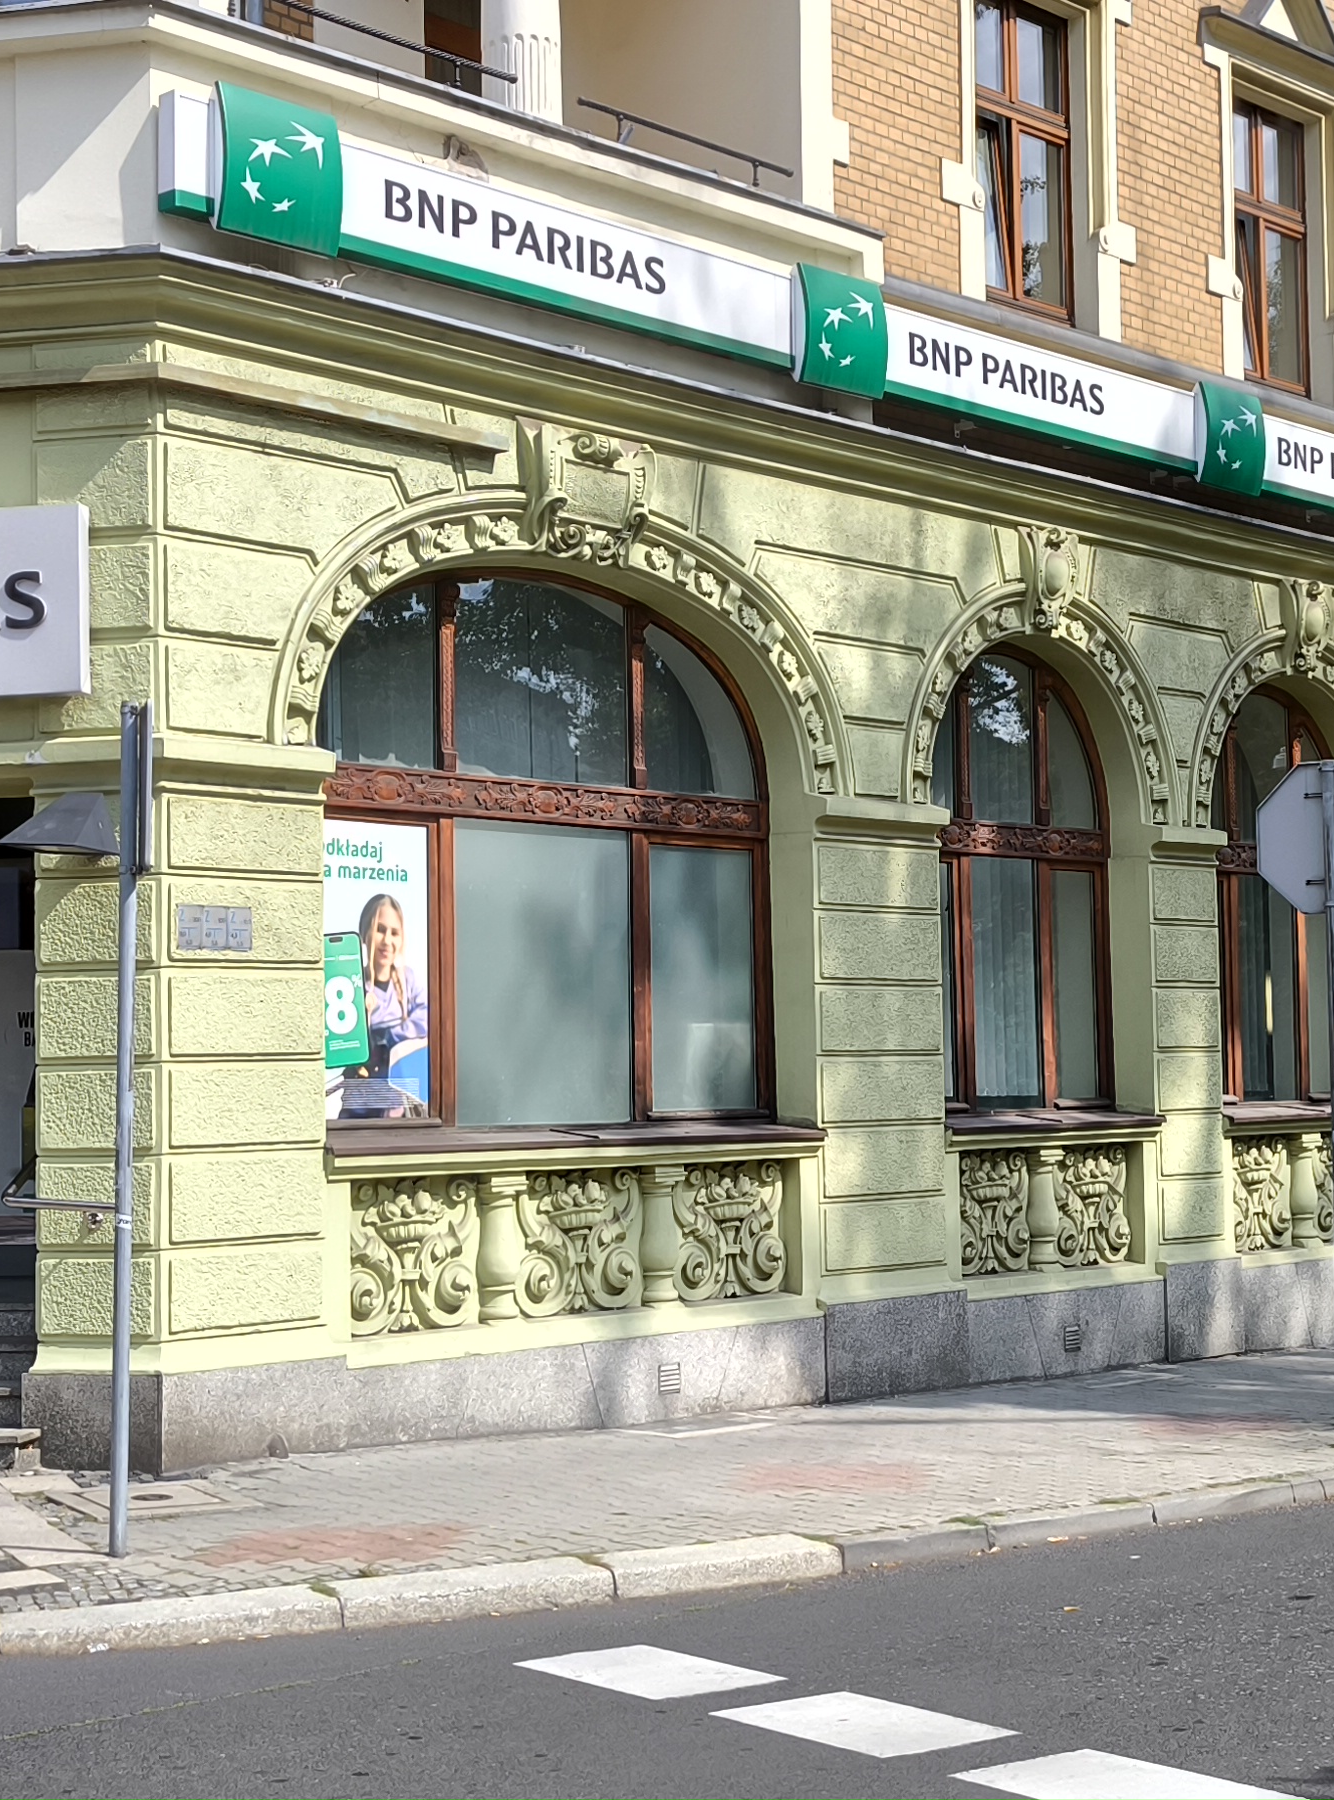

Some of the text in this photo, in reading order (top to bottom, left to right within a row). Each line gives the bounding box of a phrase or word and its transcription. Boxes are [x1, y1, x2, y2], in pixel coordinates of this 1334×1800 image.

[384, 178, 666, 295] BNP PARIBAS
[908, 331, 1105, 416] BNP PARIBAS
[1277, 436, 1324, 474] BNP
[323, 837, 383, 863] dkładaj
[338, 864, 408, 882] marzenia
